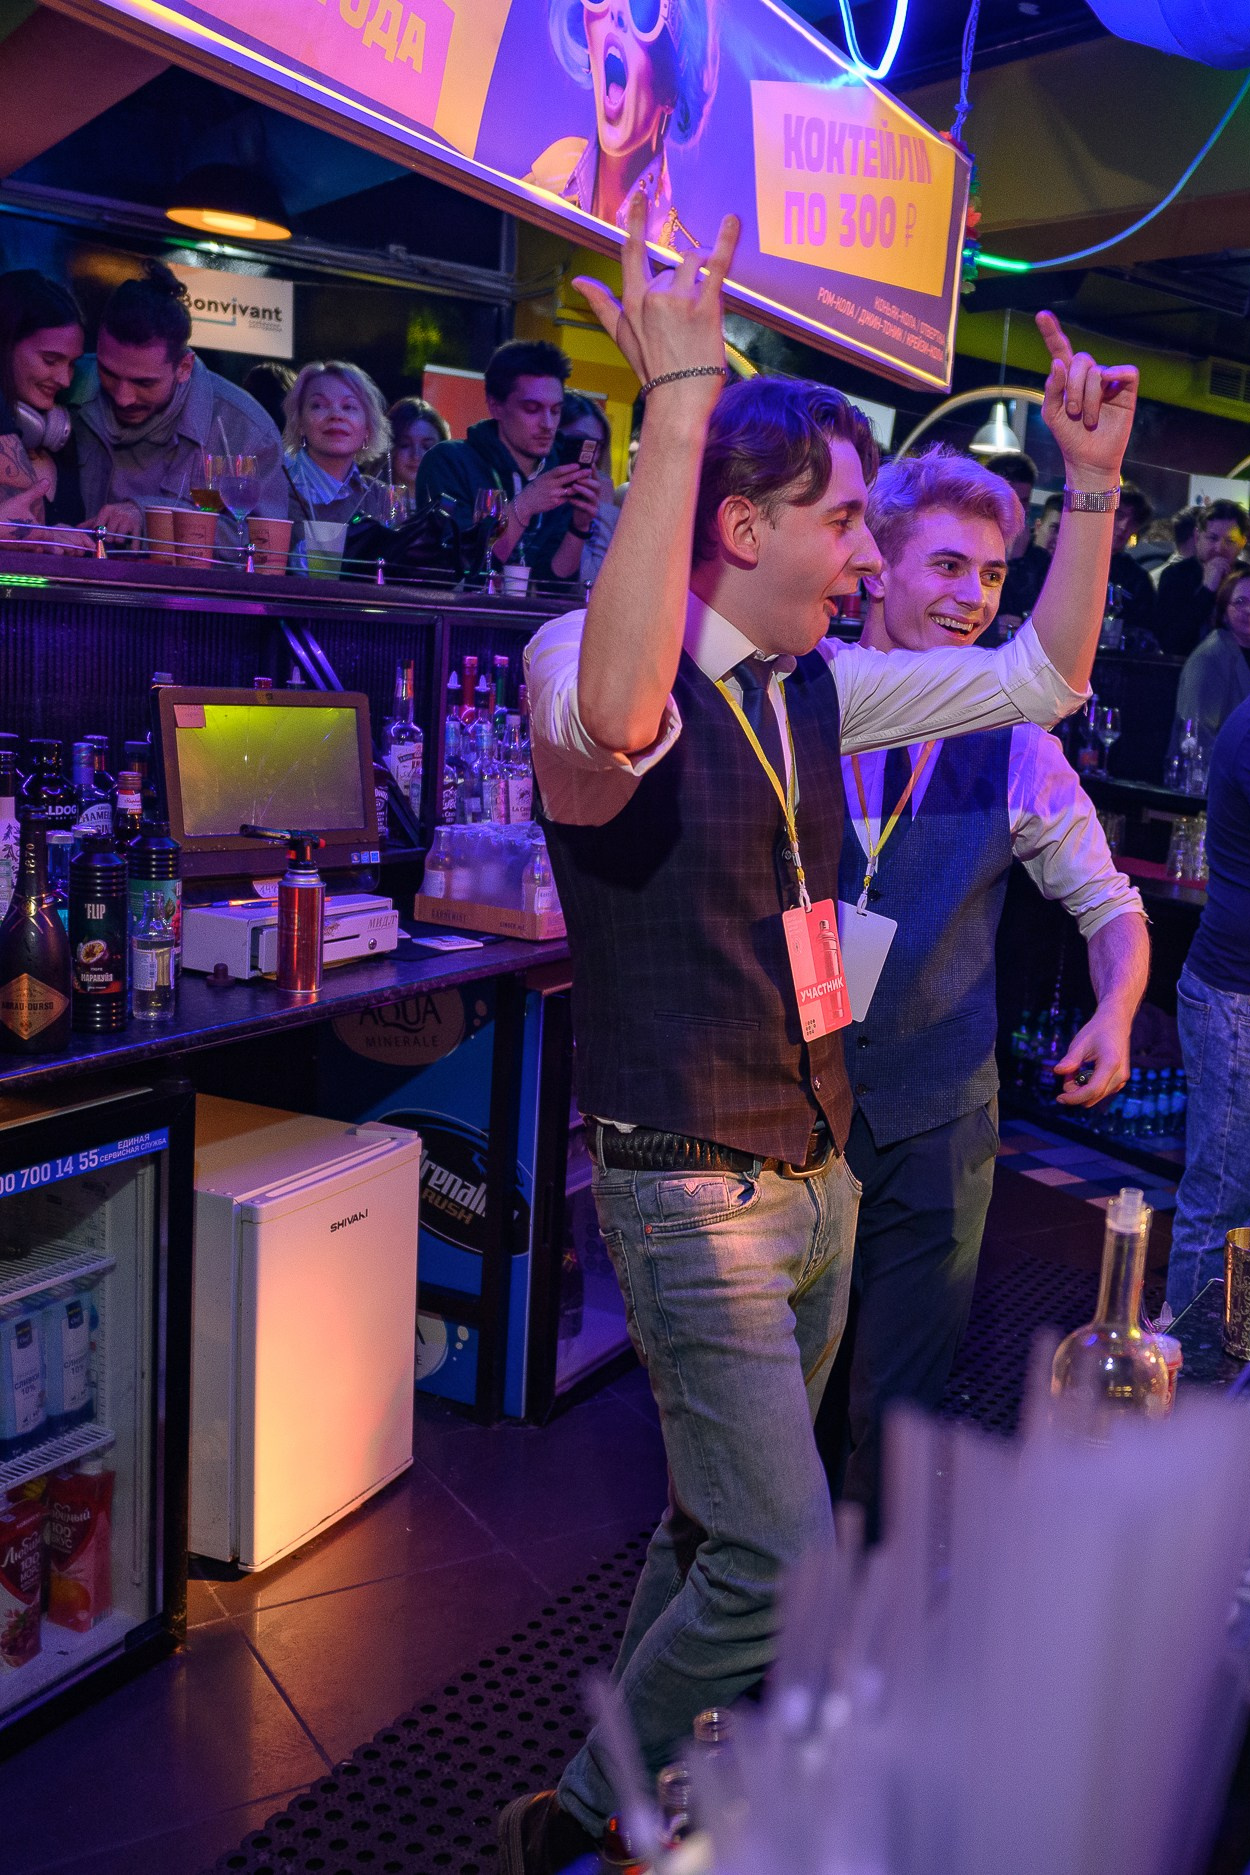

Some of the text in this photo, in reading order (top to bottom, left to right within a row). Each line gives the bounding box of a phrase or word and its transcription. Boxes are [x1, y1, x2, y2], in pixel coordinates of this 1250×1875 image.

[783, 113, 932, 185] КОКТЕЙЛИ
[784, 190, 827, 247] ПО
[839, 192, 897, 249] 300
[182, 293, 283, 322] Bonvivant
[818, 286, 856, 319] РОМ-КОЛА
[45, 804, 78, 816] LDOG
[24, 843, 36, 875] 1870
[367, 914, 397, 930] МИДЛ
[80, 972, 113, 982] МАРАКУЙЯ
[799, 976, 845, 1003] УЧАСТНИК
[360, 995, 442, 1033] AQUA
[365, 1035, 438, 1048] MINERALE
[99, 1147, 140, 1163] СЕРВИСНАЯ
[140, 1137, 167, 1151] СЛУЖБА
[117, 1133, 150, 1150] ЕДИНАЯ
[20, 1163, 51, 1189] 700
[55, 1156, 74, 1179] 14
[421, 1187, 474, 1225] RUSH
[330, 1208, 369, 1233] SHIVAKI
[14, 1373, 40, 1390] СЛИВКИ
[51, 1521, 72, 1539] 100
[51, 1535, 73, 1549] ВКУС
[20, 1552, 40, 1573] 100
